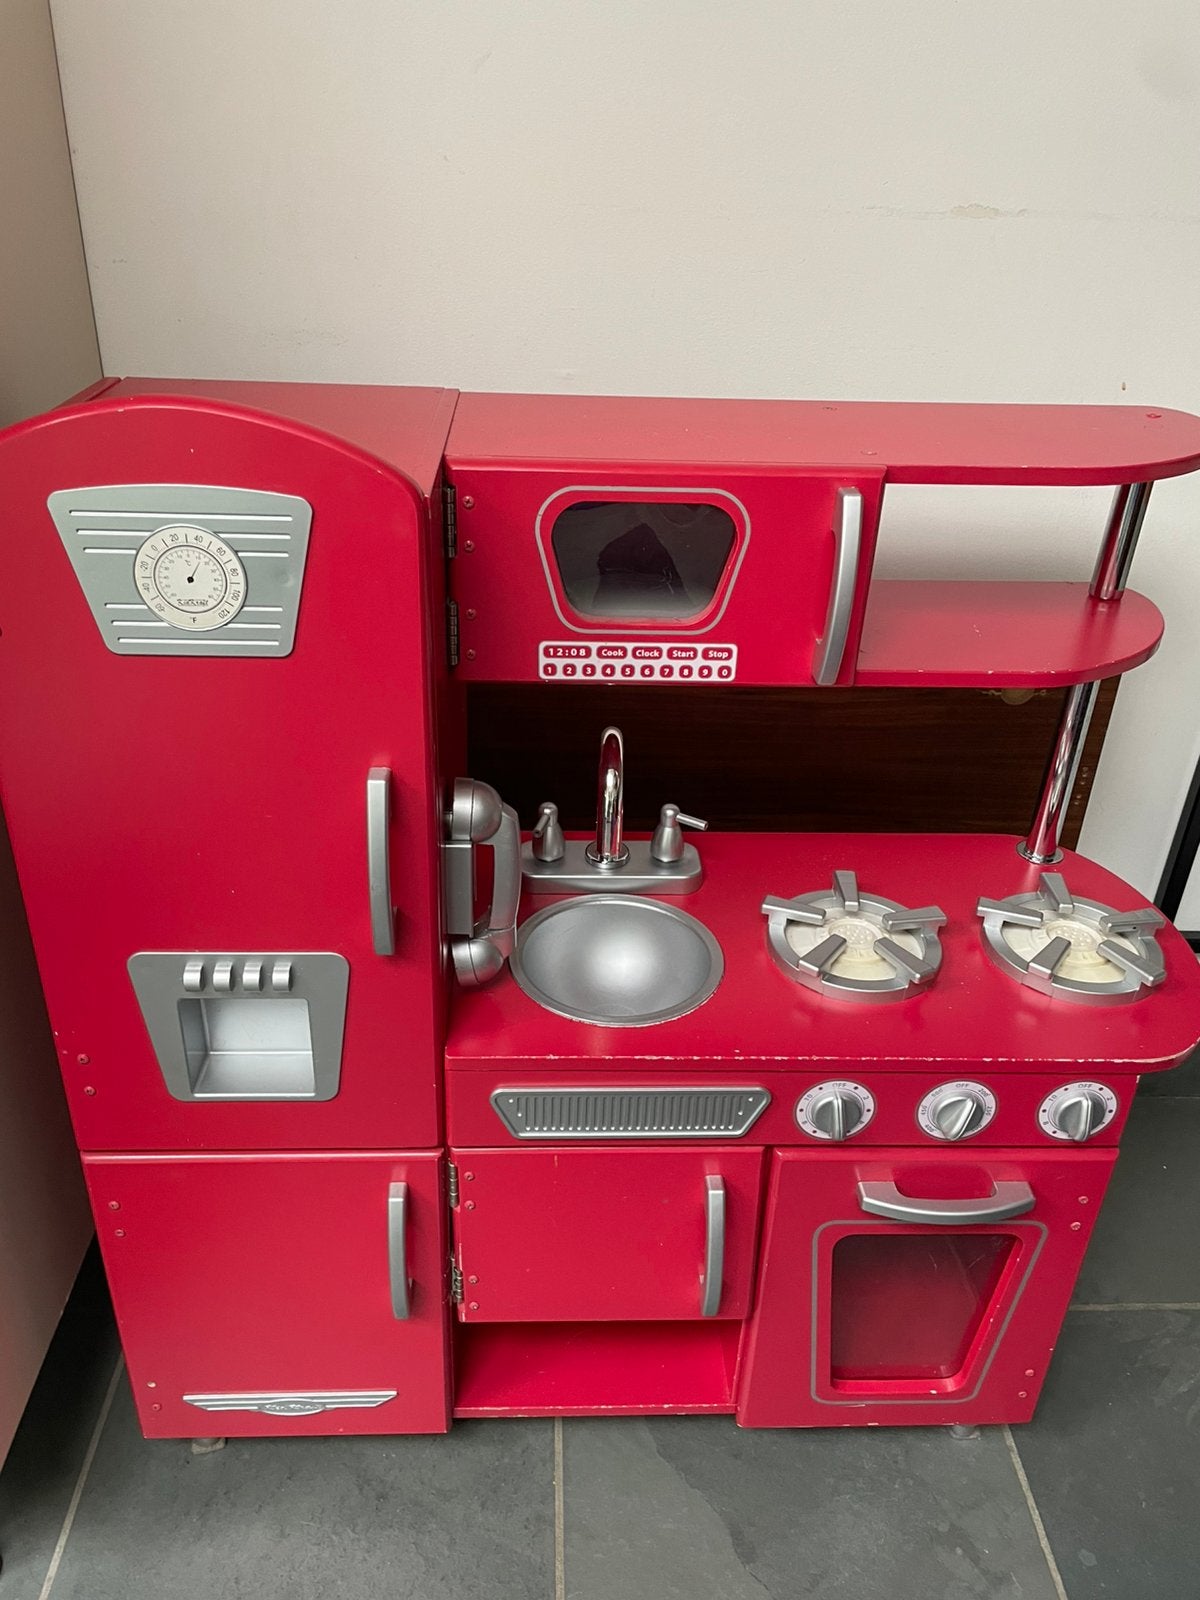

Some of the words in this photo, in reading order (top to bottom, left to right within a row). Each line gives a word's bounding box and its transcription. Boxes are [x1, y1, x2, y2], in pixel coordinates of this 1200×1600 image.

[169, 533, 179, 542] 20
[193, 534, 204, 543] 40
[150, 544, 158, 552] 0
[216, 547, 226, 557] 60
[229, 567, 239, 577] 80
[231, 589, 241, 602] 100
[218, 608, 230, 619] 120
[548, 648, 586, 657] 12:08
[601, 648, 624, 657] Cook
[635, 649, 660, 657] Clock
[672, 650, 694, 658] Start
[708, 650, 729, 659] Stop
